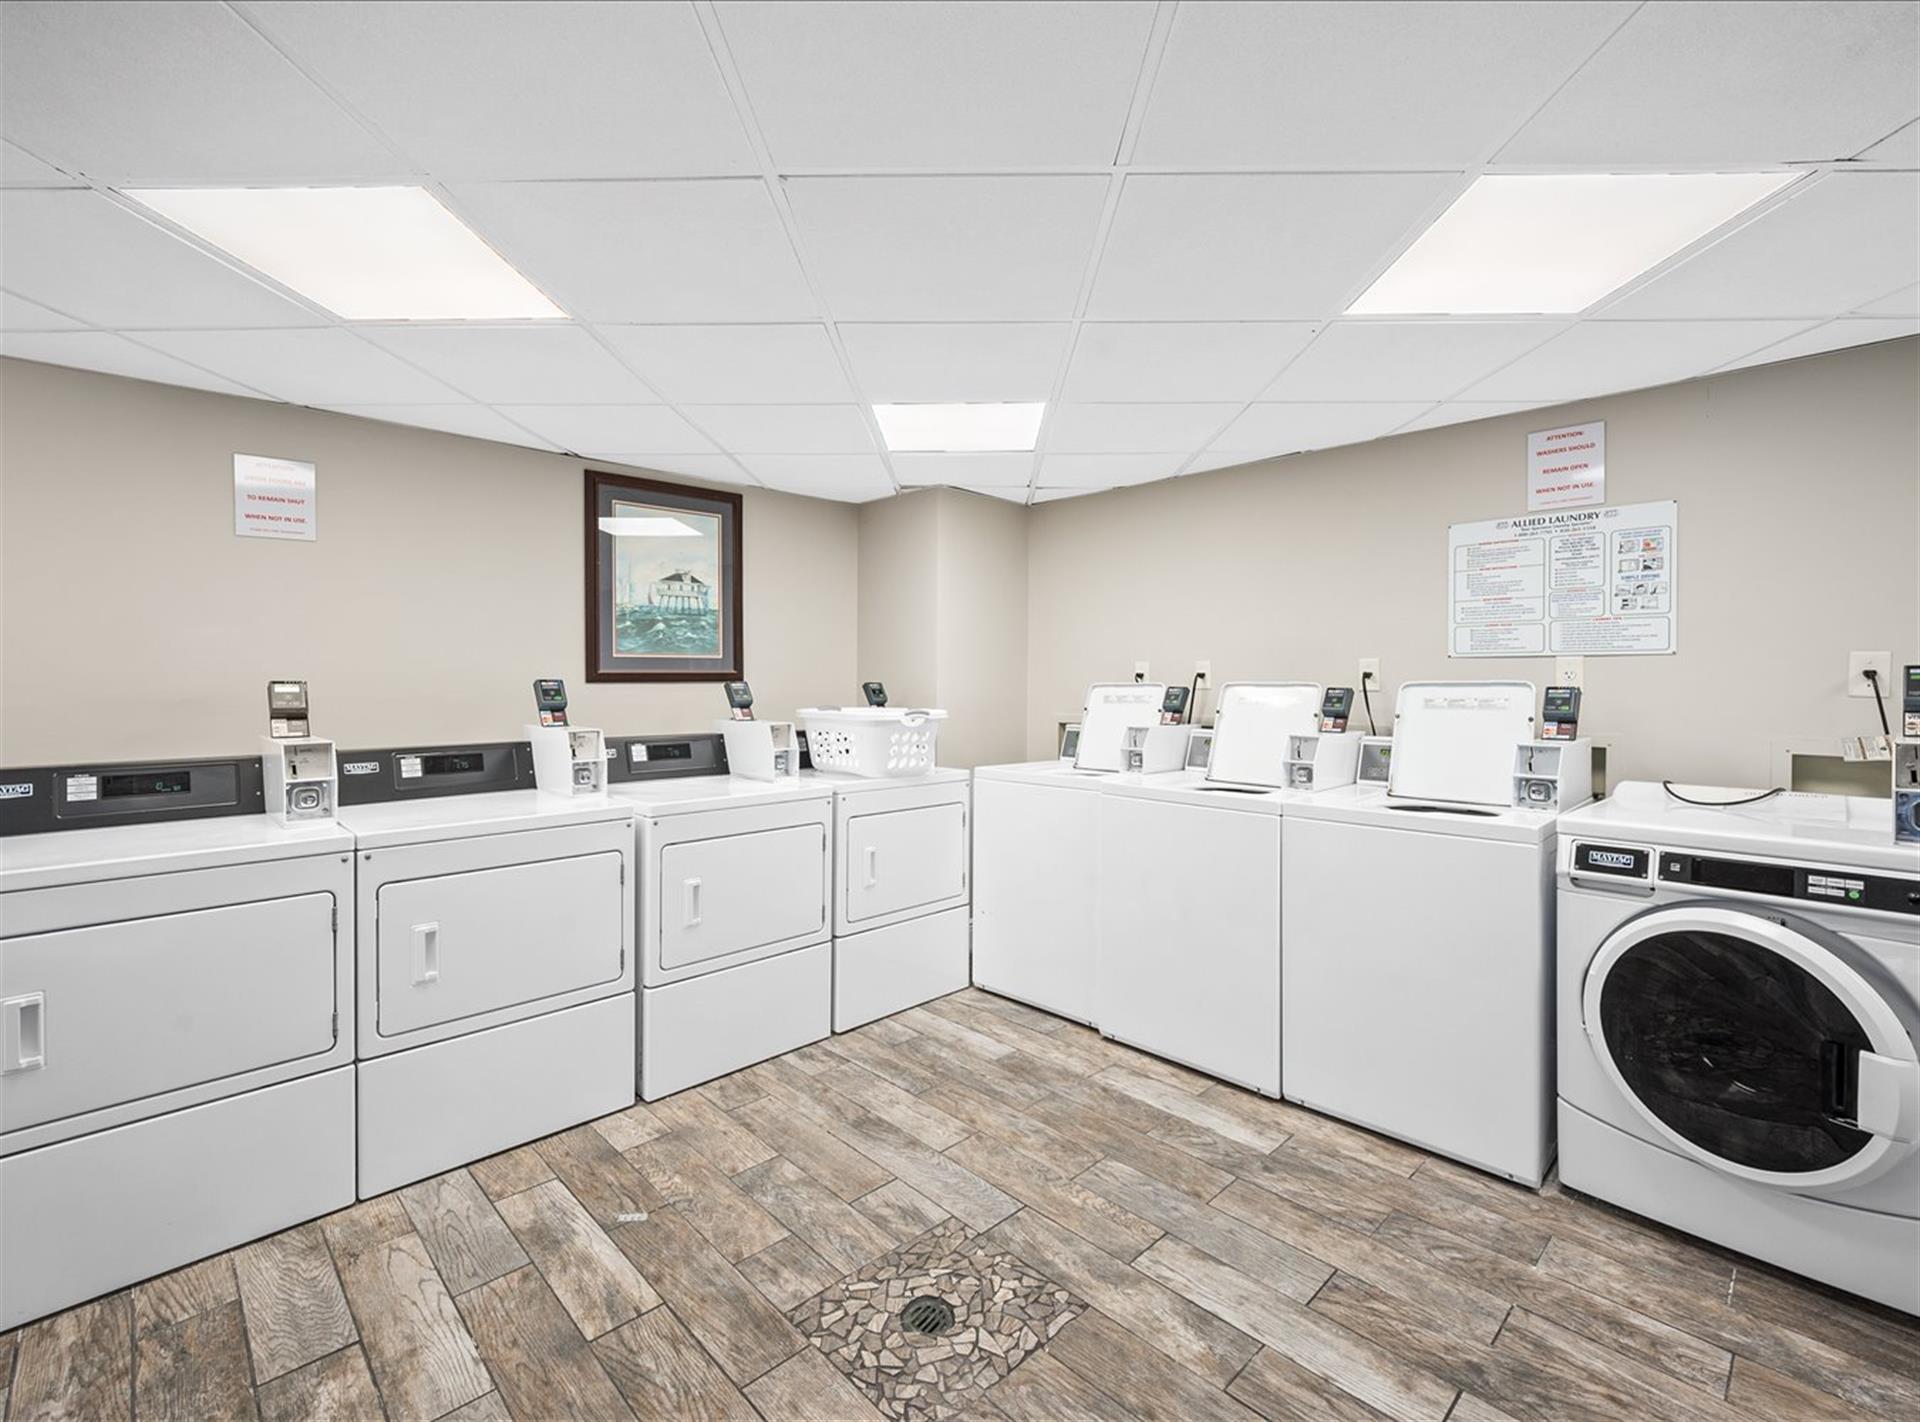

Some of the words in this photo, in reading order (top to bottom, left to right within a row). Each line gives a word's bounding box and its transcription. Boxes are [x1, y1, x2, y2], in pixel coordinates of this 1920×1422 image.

[1536, 447, 1567, 456] WASHERS
[1568, 442, 1595, 451] SHOULD
[1542, 466, 1569, 474] REMAIN
[1570, 463, 1589, 471] OPEN
[258, 495, 285, 503] REMAIN
[1511, 517, 1546, 528] ALLIED
[1548, 511, 1602, 524] LAUNDRY
[1590, 851, 1632, 866] MAYTAG
